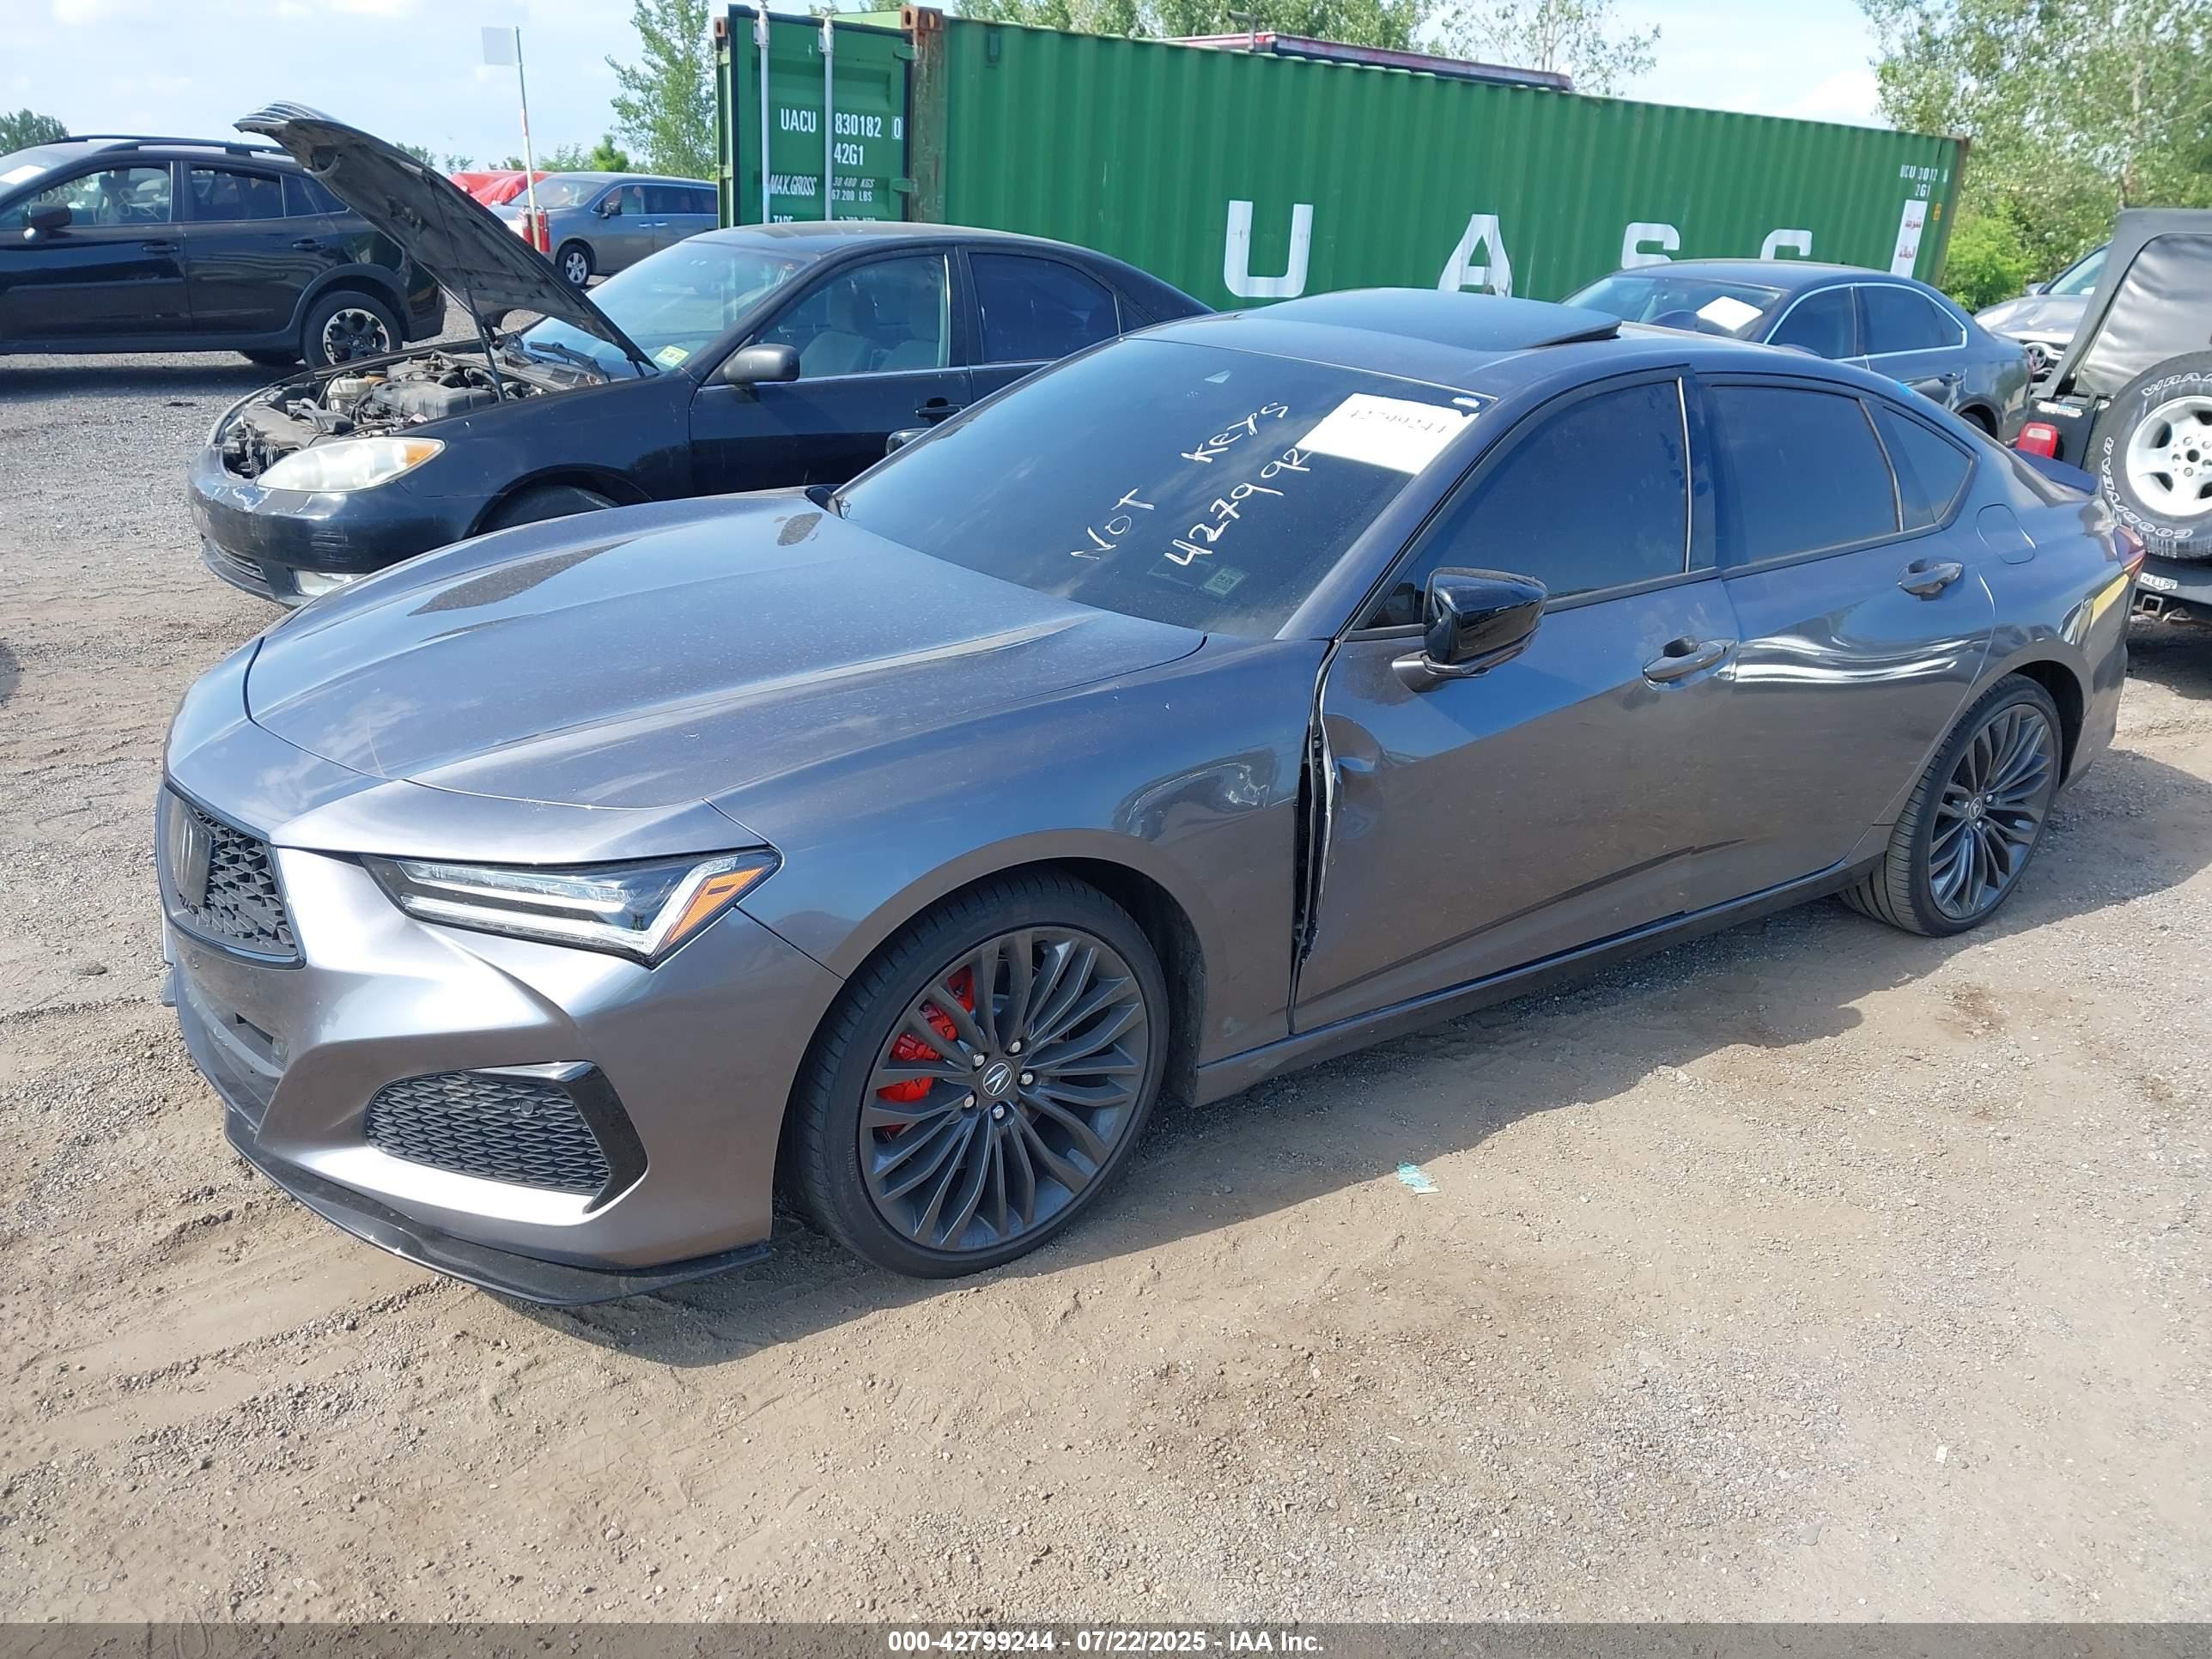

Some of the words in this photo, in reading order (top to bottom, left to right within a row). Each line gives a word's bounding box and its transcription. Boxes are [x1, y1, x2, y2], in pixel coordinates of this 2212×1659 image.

[781, 108, 817, 133] UACU
[835, 112, 882, 137] 830182
[893, 118, 902, 138] 0
[834, 143, 864, 166] 42G1
[859, 191, 873, 202] LBS
[2103, 436, 2193, 539] GOODYEAR
